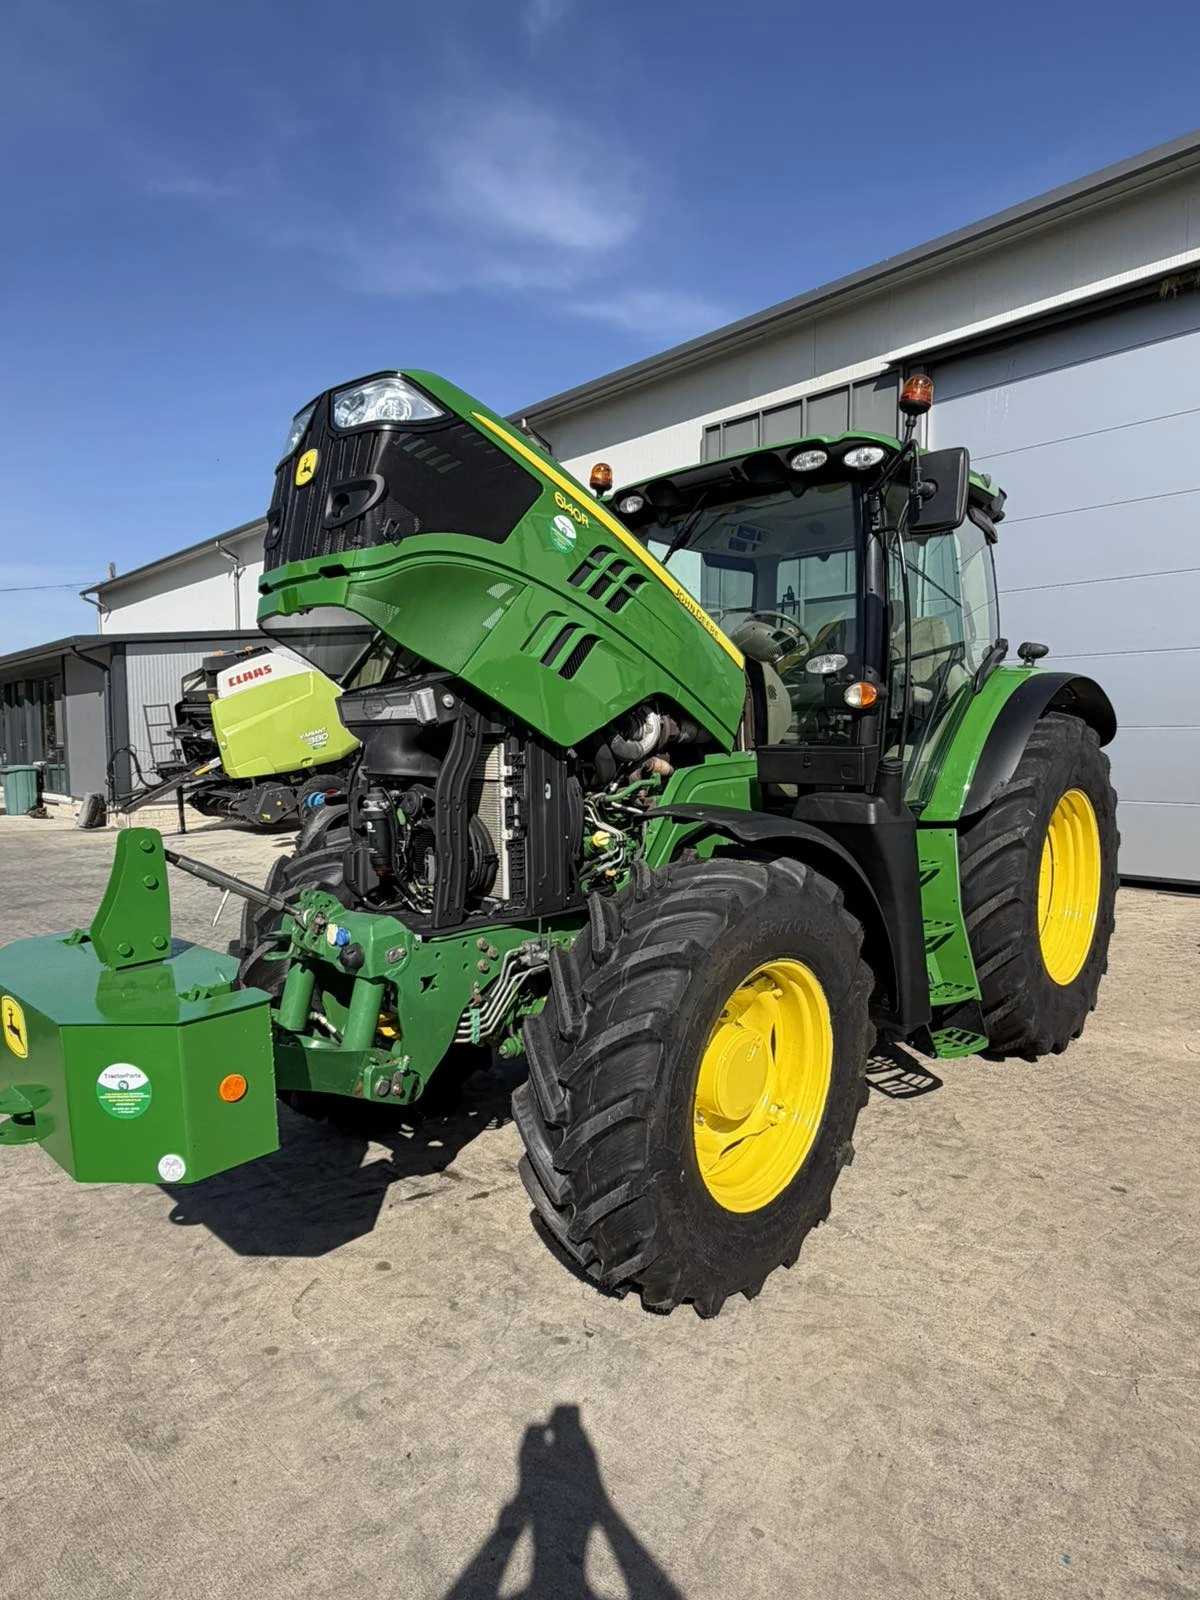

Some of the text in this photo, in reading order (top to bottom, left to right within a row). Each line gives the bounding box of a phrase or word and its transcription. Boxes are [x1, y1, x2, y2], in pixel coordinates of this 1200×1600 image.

[555, 491, 589, 528] 6140R
[675, 588, 719, 637] JOHN DEERE
[228, 664, 272, 687] CLAAS
